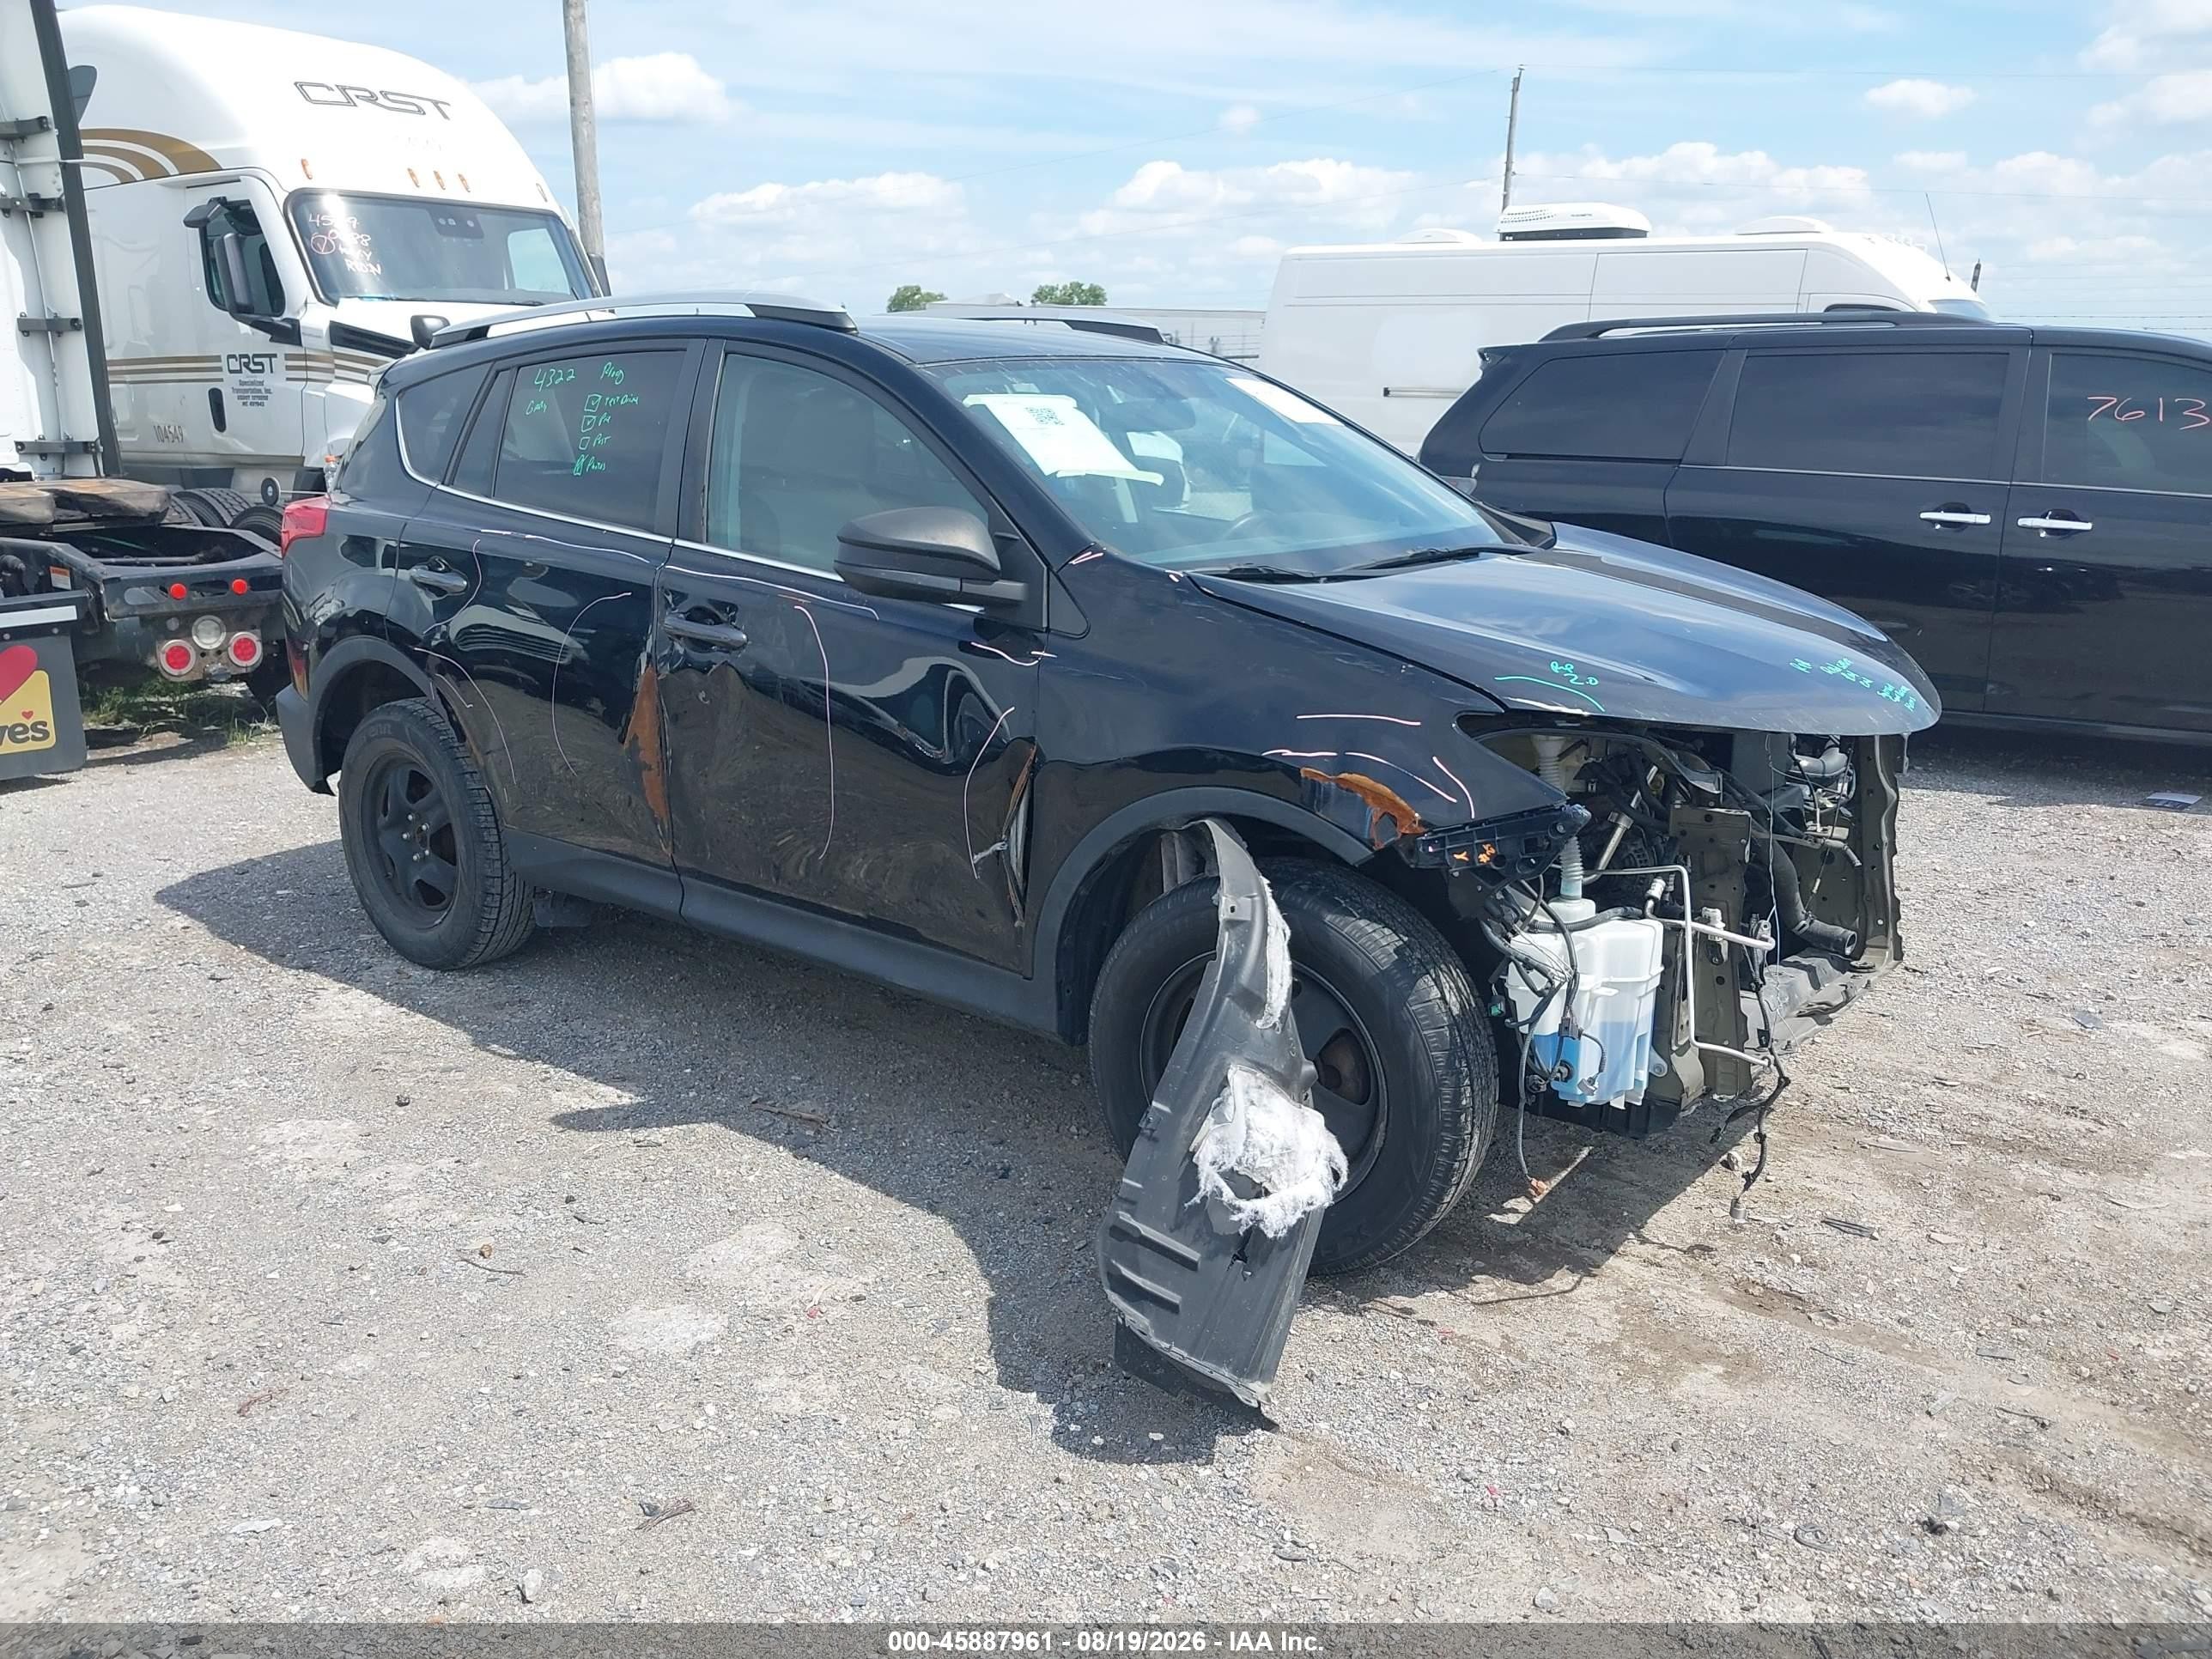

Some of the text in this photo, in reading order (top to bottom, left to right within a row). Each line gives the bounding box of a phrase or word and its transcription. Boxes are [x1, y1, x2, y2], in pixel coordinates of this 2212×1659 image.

[294, 82, 451, 120] CRST
[227, 353, 277, 374] CRST
[534, 368, 575, 392] 4322
[2087, 396, 2211, 429] 7613
